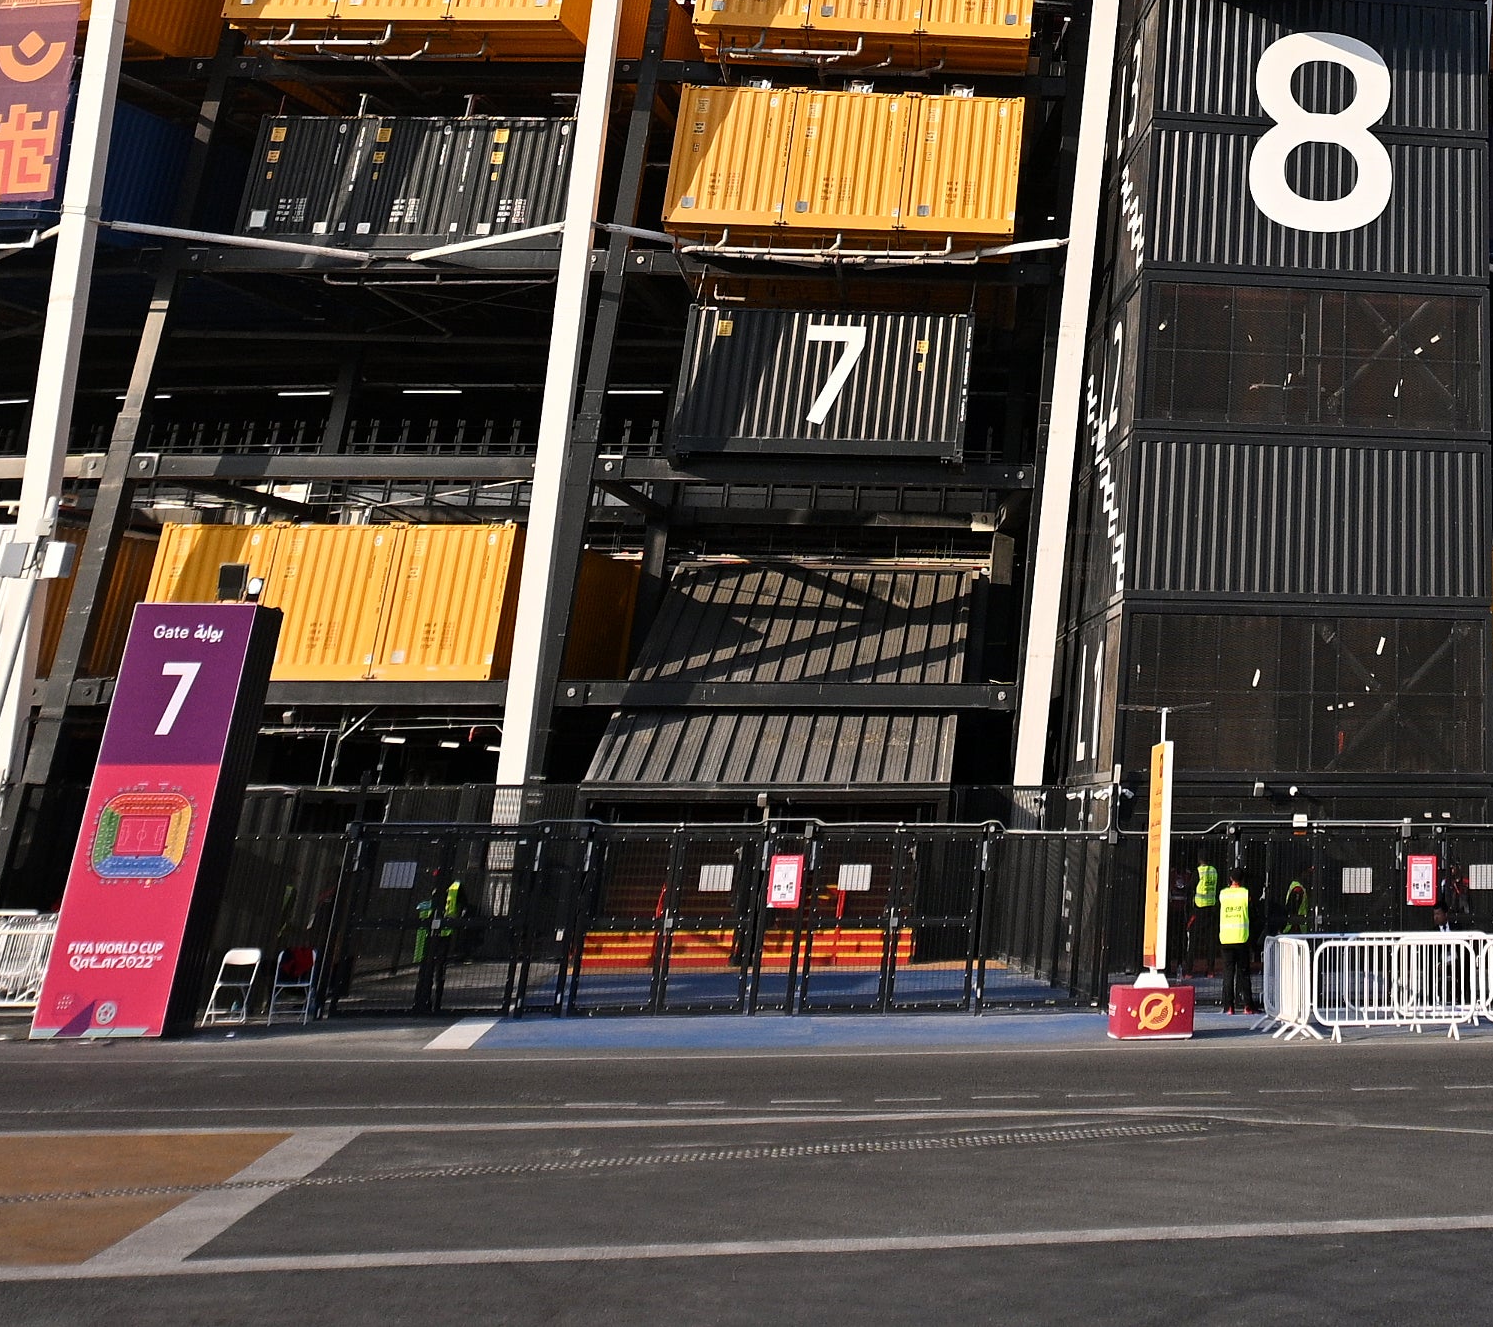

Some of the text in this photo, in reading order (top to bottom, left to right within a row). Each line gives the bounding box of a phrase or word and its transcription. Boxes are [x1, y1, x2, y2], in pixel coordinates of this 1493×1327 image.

[1248, 31, 1393, 233] 8
[806, 324, 867, 426] 7
[153, 624, 190, 639] Gate
[193, 623, 224, 643] بوابة
[154, 662, 203, 736] 7
[67, 942, 164, 955] FIFA WORLD CUP
